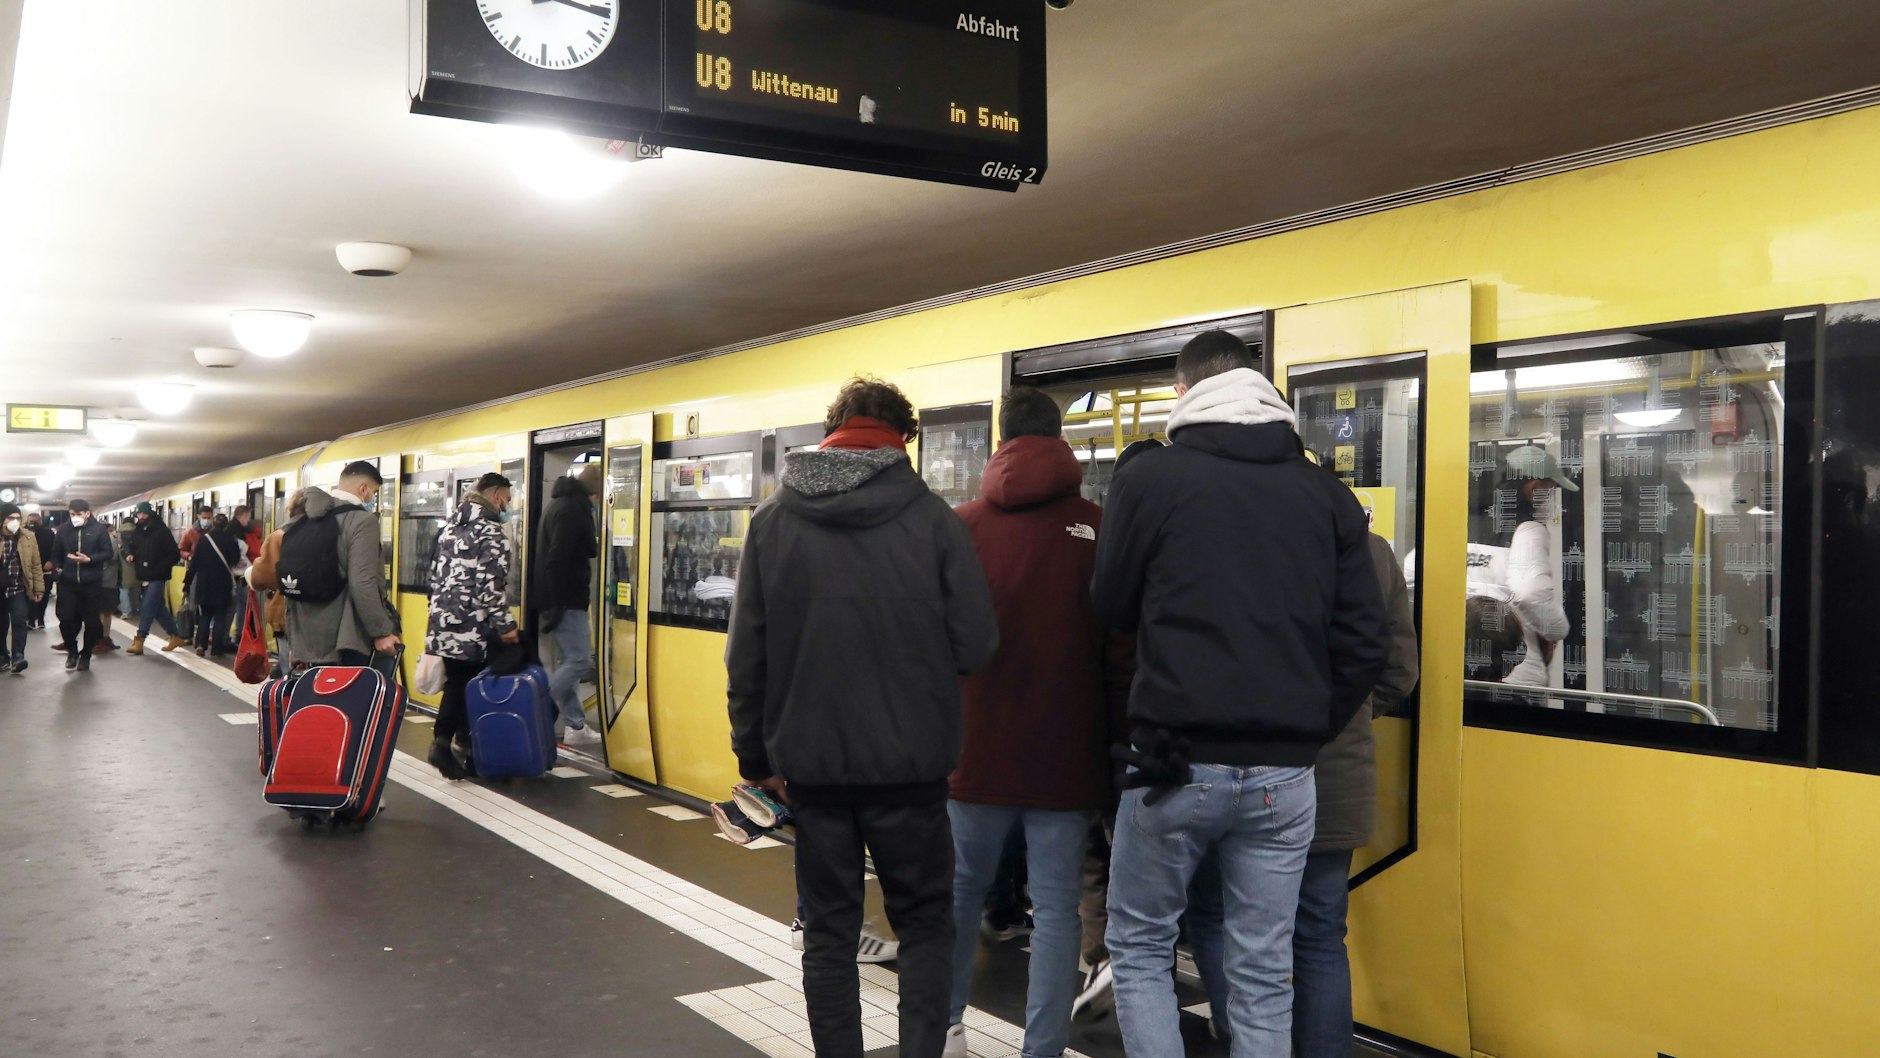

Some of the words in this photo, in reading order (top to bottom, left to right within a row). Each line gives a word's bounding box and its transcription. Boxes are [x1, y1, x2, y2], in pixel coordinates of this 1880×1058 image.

[696, 0, 731, 34] U8
[956, 13, 1020, 41] Abfahrt
[696, 52, 731, 90] U8
[752, 69, 838, 104] Wittenau
[950, 102, 966, 124] in
[992, 111, 1019, 132] min
[981, 161, 1022, 181] Gleis
[1024, 167, 1037, 182] 2
[1066, 526, 1088, 534] NORTH
